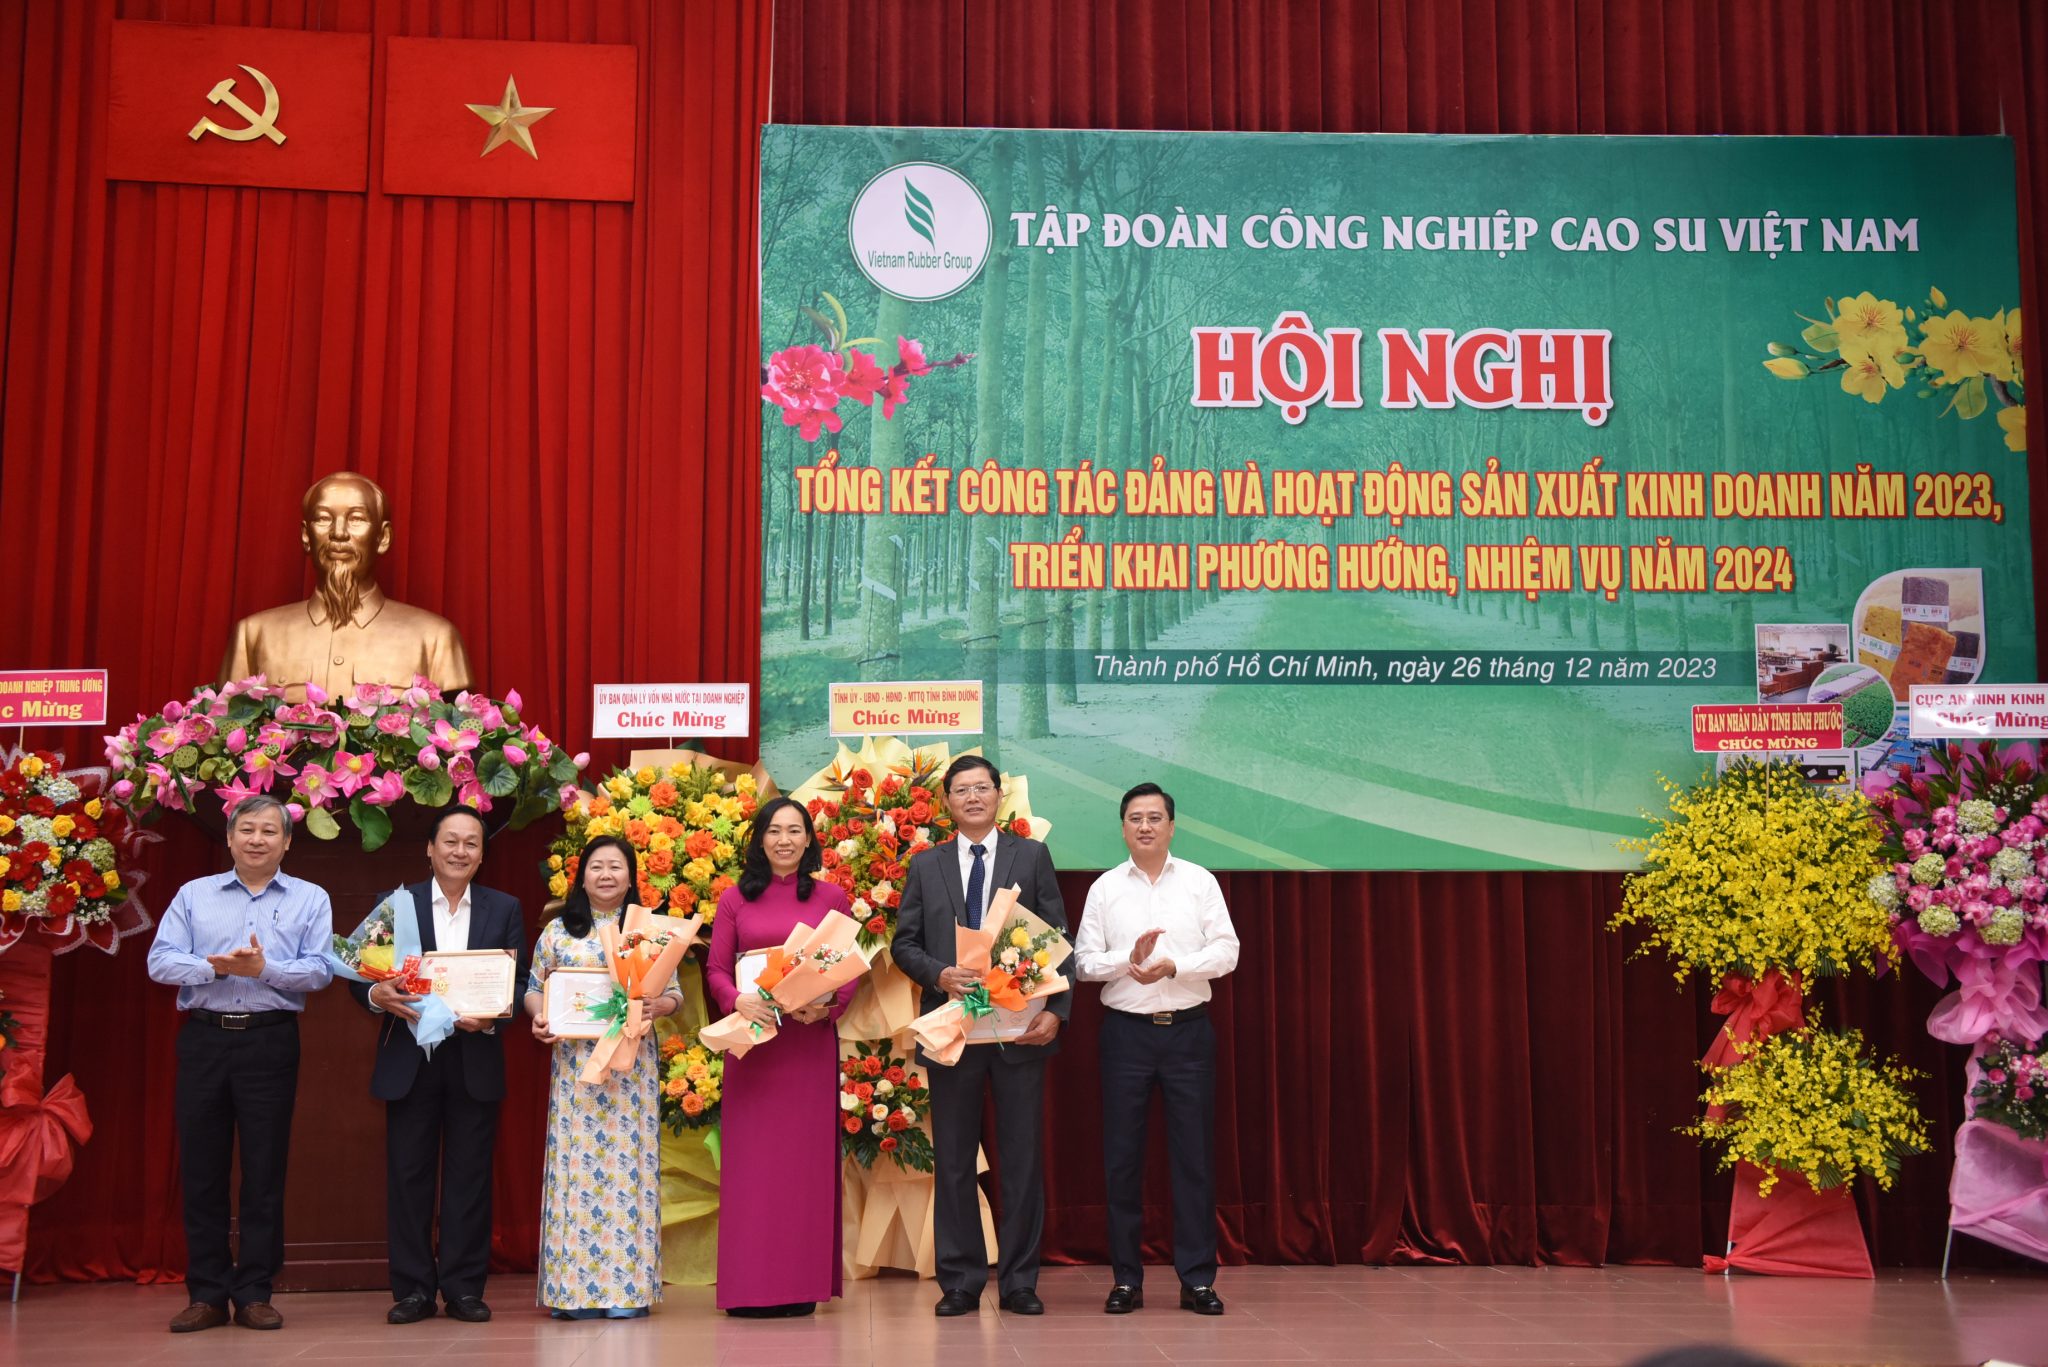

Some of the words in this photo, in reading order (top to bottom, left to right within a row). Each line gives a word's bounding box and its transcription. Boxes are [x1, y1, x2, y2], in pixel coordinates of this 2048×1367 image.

[1009, 204, 1091, 255] TẬP
[1102, 206, 1228, 249] ĐOÀN
[1241, 207, 1369, 250] CÔNG
[1381, 209, 1539, 260] NGHIỆP
[1550, 216, 1640, 252] CAO
[1653, 217, 1707, 252] SU
[1717, 210, 1808, 260] VIỆT
[1820, 218, 1920, 252] NAM
[868, 250, 905, 268] Vietnam
[907, 251, 941, 269] Rubber
[943, 251, 973, 273] Group
[1190, 310, 1363, 425] HỘI
[1377, 327, 1614, 426] NGHỊ
[795, 449, 882, 514] TỔNG
[889, 453, 951, 514] KẾT
[957, 459, 1048, 515] CÔNG
[1056, 461, 1118, 515] TÁC
[1124, 456, 1215, 516] ĐẢNG
[1221, 461, 1266, 516] VÀ
[1272, 470, 1357, 526] HOẠT
[1363, 462, 1454, 526] ĐỘNG
[1460, 456, 1529, 517] SẢN
[1535, 456, 1618, 518] XUẤT
[1626, 472, 1705, 518] KINH
[1711, 472, 1822, 519] DOANH
[1829, 463, 1906, 518] NĂM
[1913, 472, 2003, 523] 2023,
[1009, 524, 1104, 590] TRIỂN
[1112, 543, 1190, 590] KHAI
[1197, 539, 1330, 591] PHƯƠNG
[1337, 535, 1458, 597] HƯỚNG,
[1465, 536, 1573, 601] NHIỆM
[1578, 545, 1622, 601] VỤ
[1629, 536, 1706, 591] NĂM
[1713, 546, 1795, 592] 2024
[1094, 655, 1167, 677] Thành
[1174, 653, 1222, 681] phố
[1226, 652, 1261, 677] Hồ
[1268, 655, 1311, 677] Chí
[1315, 655, 1379, 680] Minh,
[1387, 656, 1445, 683] ngày
[1451, 657, 1482, 678] 26
[1489, 656, 1555, 683] tháng
[1565, 657, 1592, 678] 12
[1599, 657, 1650, 678] năm
[1657, 657, 1717, 678] 2023
[24, 677, 53, 696] NGHIỆP
[55, 679, 80, 693] TRUNG
[82, 677, 103, 692] ƯƠNG
[609, 692, 620, 704] BAN
[703, 692, 722, 704] DOANH
[723, 689, 746, 707] NGHIỆP
[863, 692, 880, 703] UBND
[908, 691, 925, 704] MTTQ
[1915, 694, 1943, 708] CỤC
[1948, 694, 1967, 705] AN
[1972, 693, 2005, 705] NINH
[2011, 693, 2045, 705] KINH
[22, 700, 83, 720] Mừng
[852, 709, 900, 726] Chúc
[907, 708, 960, 726] Mừng
[1695, 706, 1706, 733] ỦY
[1708, 713, 1725, 733] BAN
[1726, 707, 1750, 732] NHÂN
[1752, 707, 1769, 732] DÂN
[1771, 705, 1791, 731] TỈNH
[1792, 706, 1813, 731] BÌNH
[1814, 705, 1842, 731] PHƯỚC
[617, 711, 665, 728] Chúc
[672, 711, 727, 729] Mừng
[1995, 711, 2048, 730] Mừng
[1718, 736, 1763, 750] CHÚC
[1767, 735, 1818, 749] MỪNG
